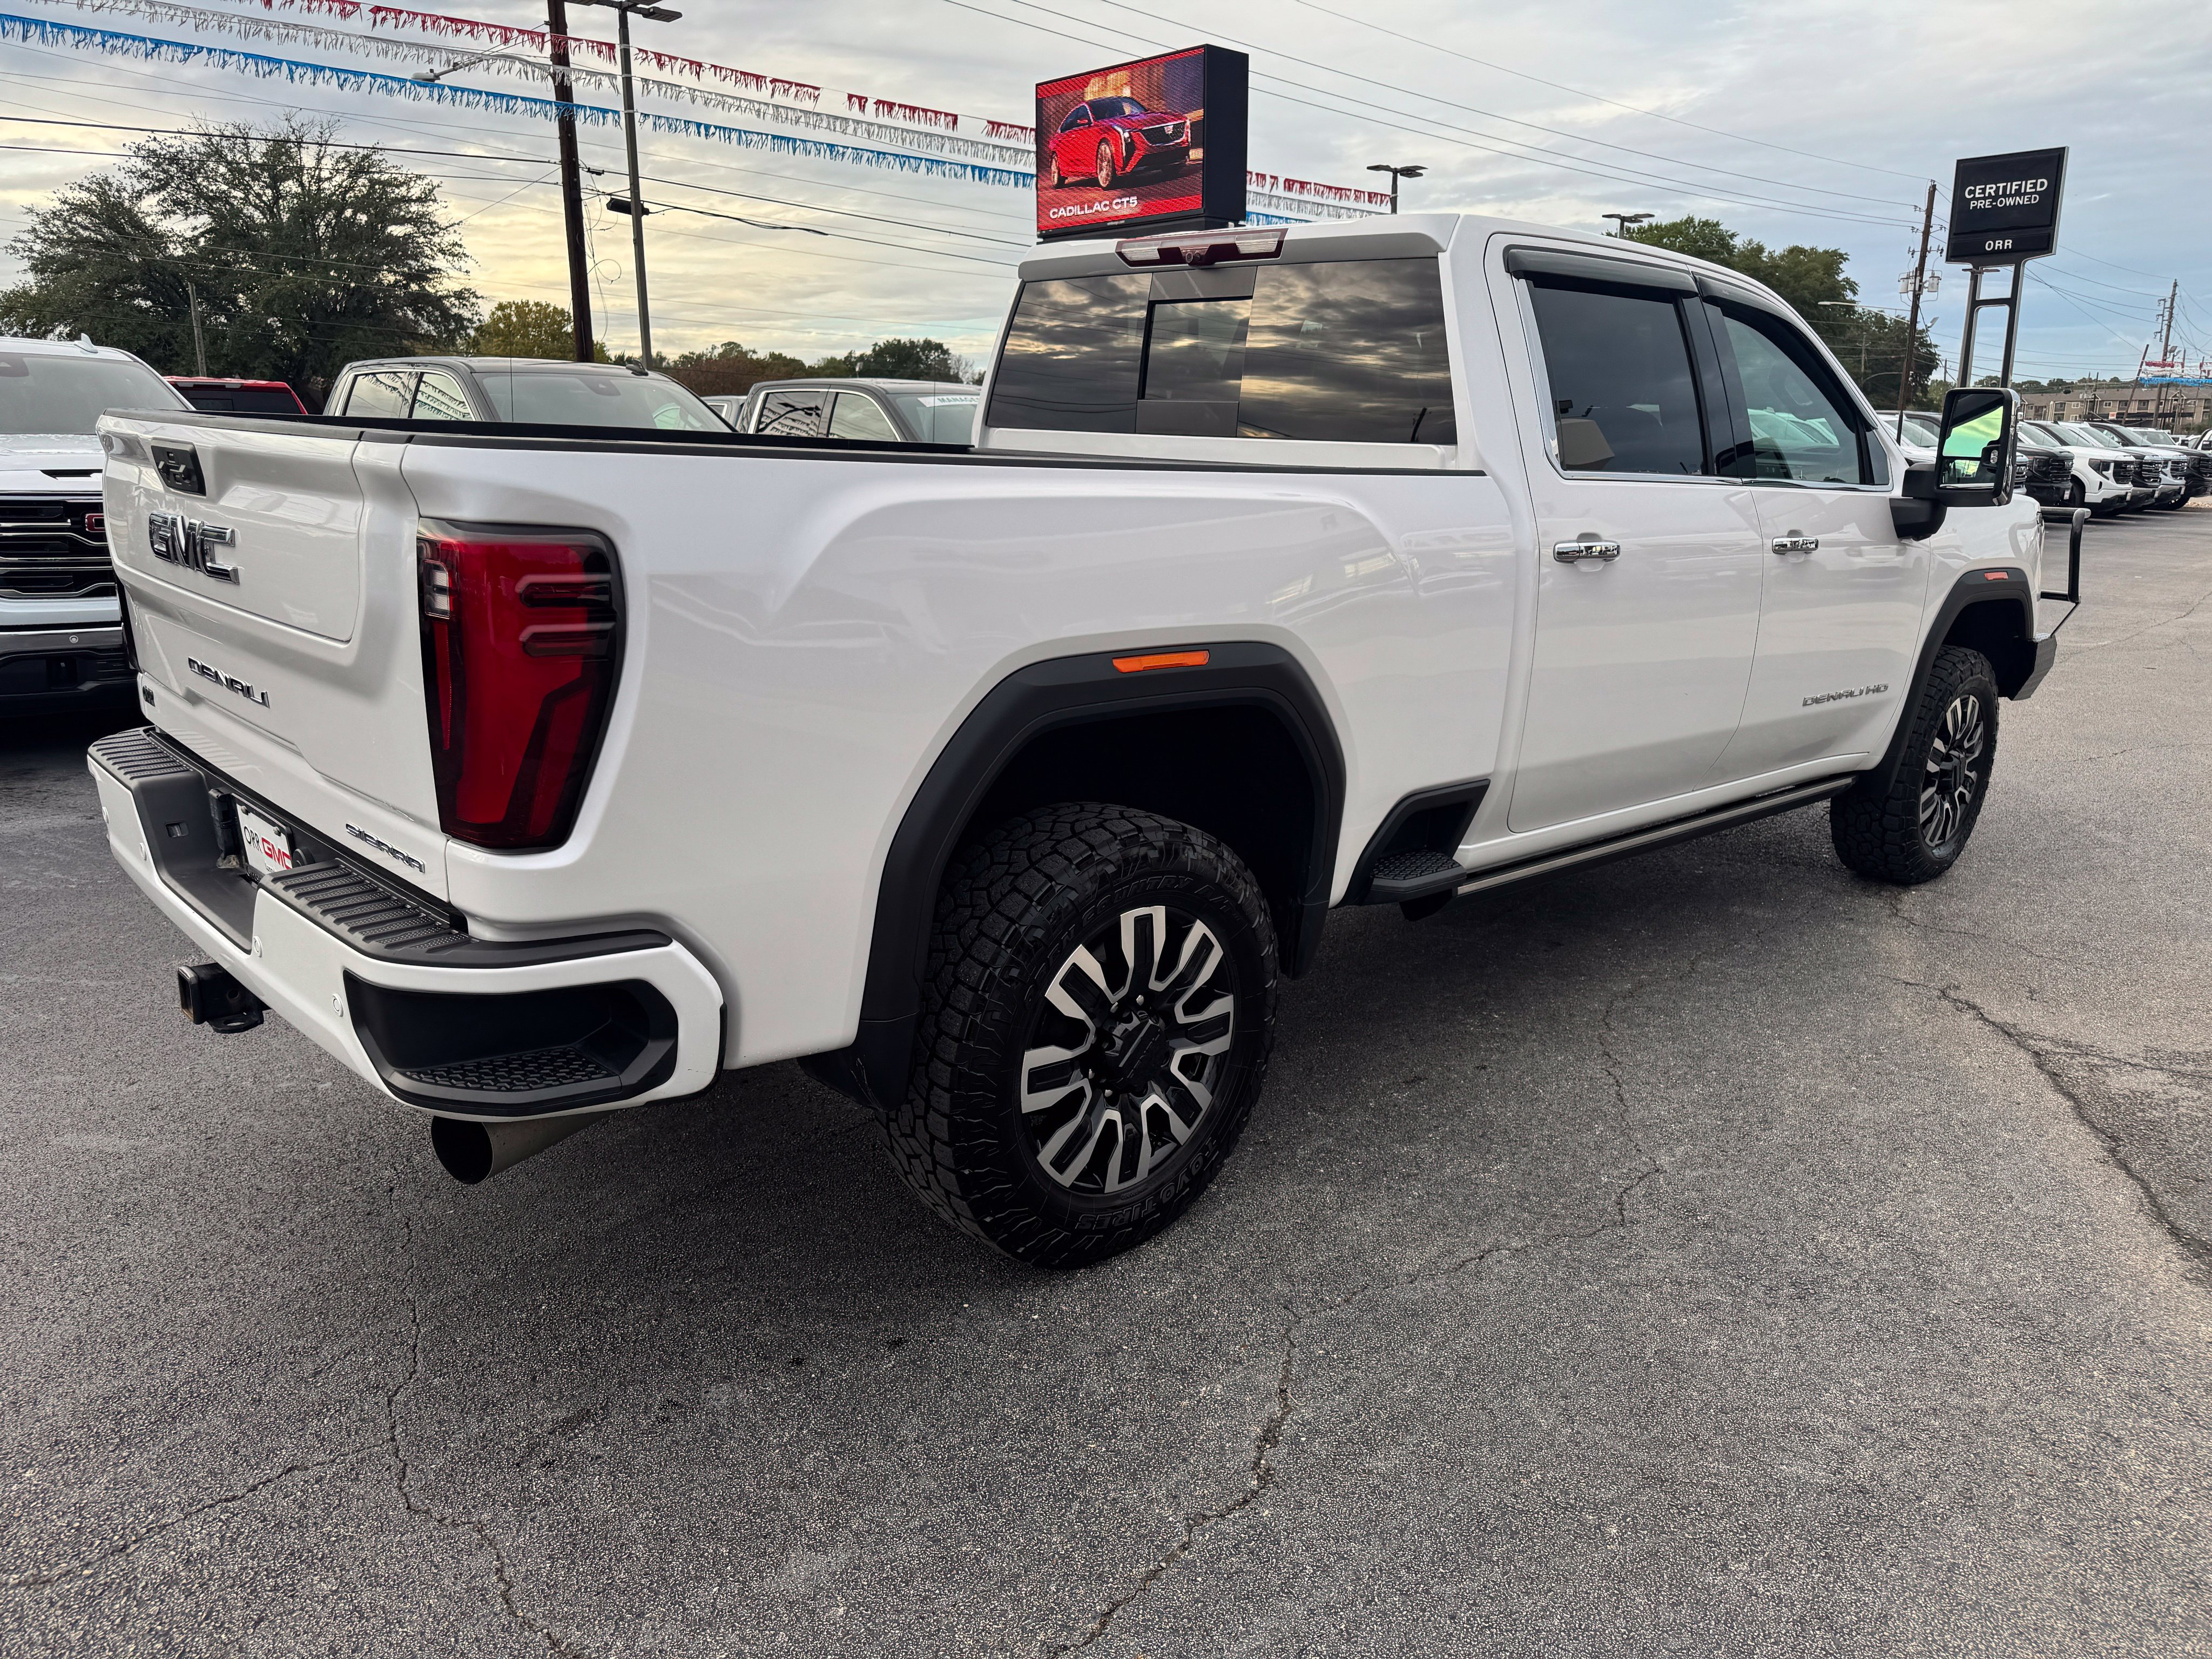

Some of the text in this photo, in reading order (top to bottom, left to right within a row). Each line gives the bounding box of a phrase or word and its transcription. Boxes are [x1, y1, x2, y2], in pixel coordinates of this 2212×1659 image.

[1965, 178, 2048, 199] CERTIFIED
[1049, 196, 1138, 219] CADILLAC CT5
[1970, 194, 2040, 210] PRE-OWNED
[1985, 239, 2013, 251] ORR
[149, 511, 240, 585] GMC
[188, 656, 270, 709] DENALI
[1803, 683, 1889, 706] DENALI HD
[244, 826, 292, 870] ORR GMC
[1075, 1137, 1219, 1230] TOYO TIRES
